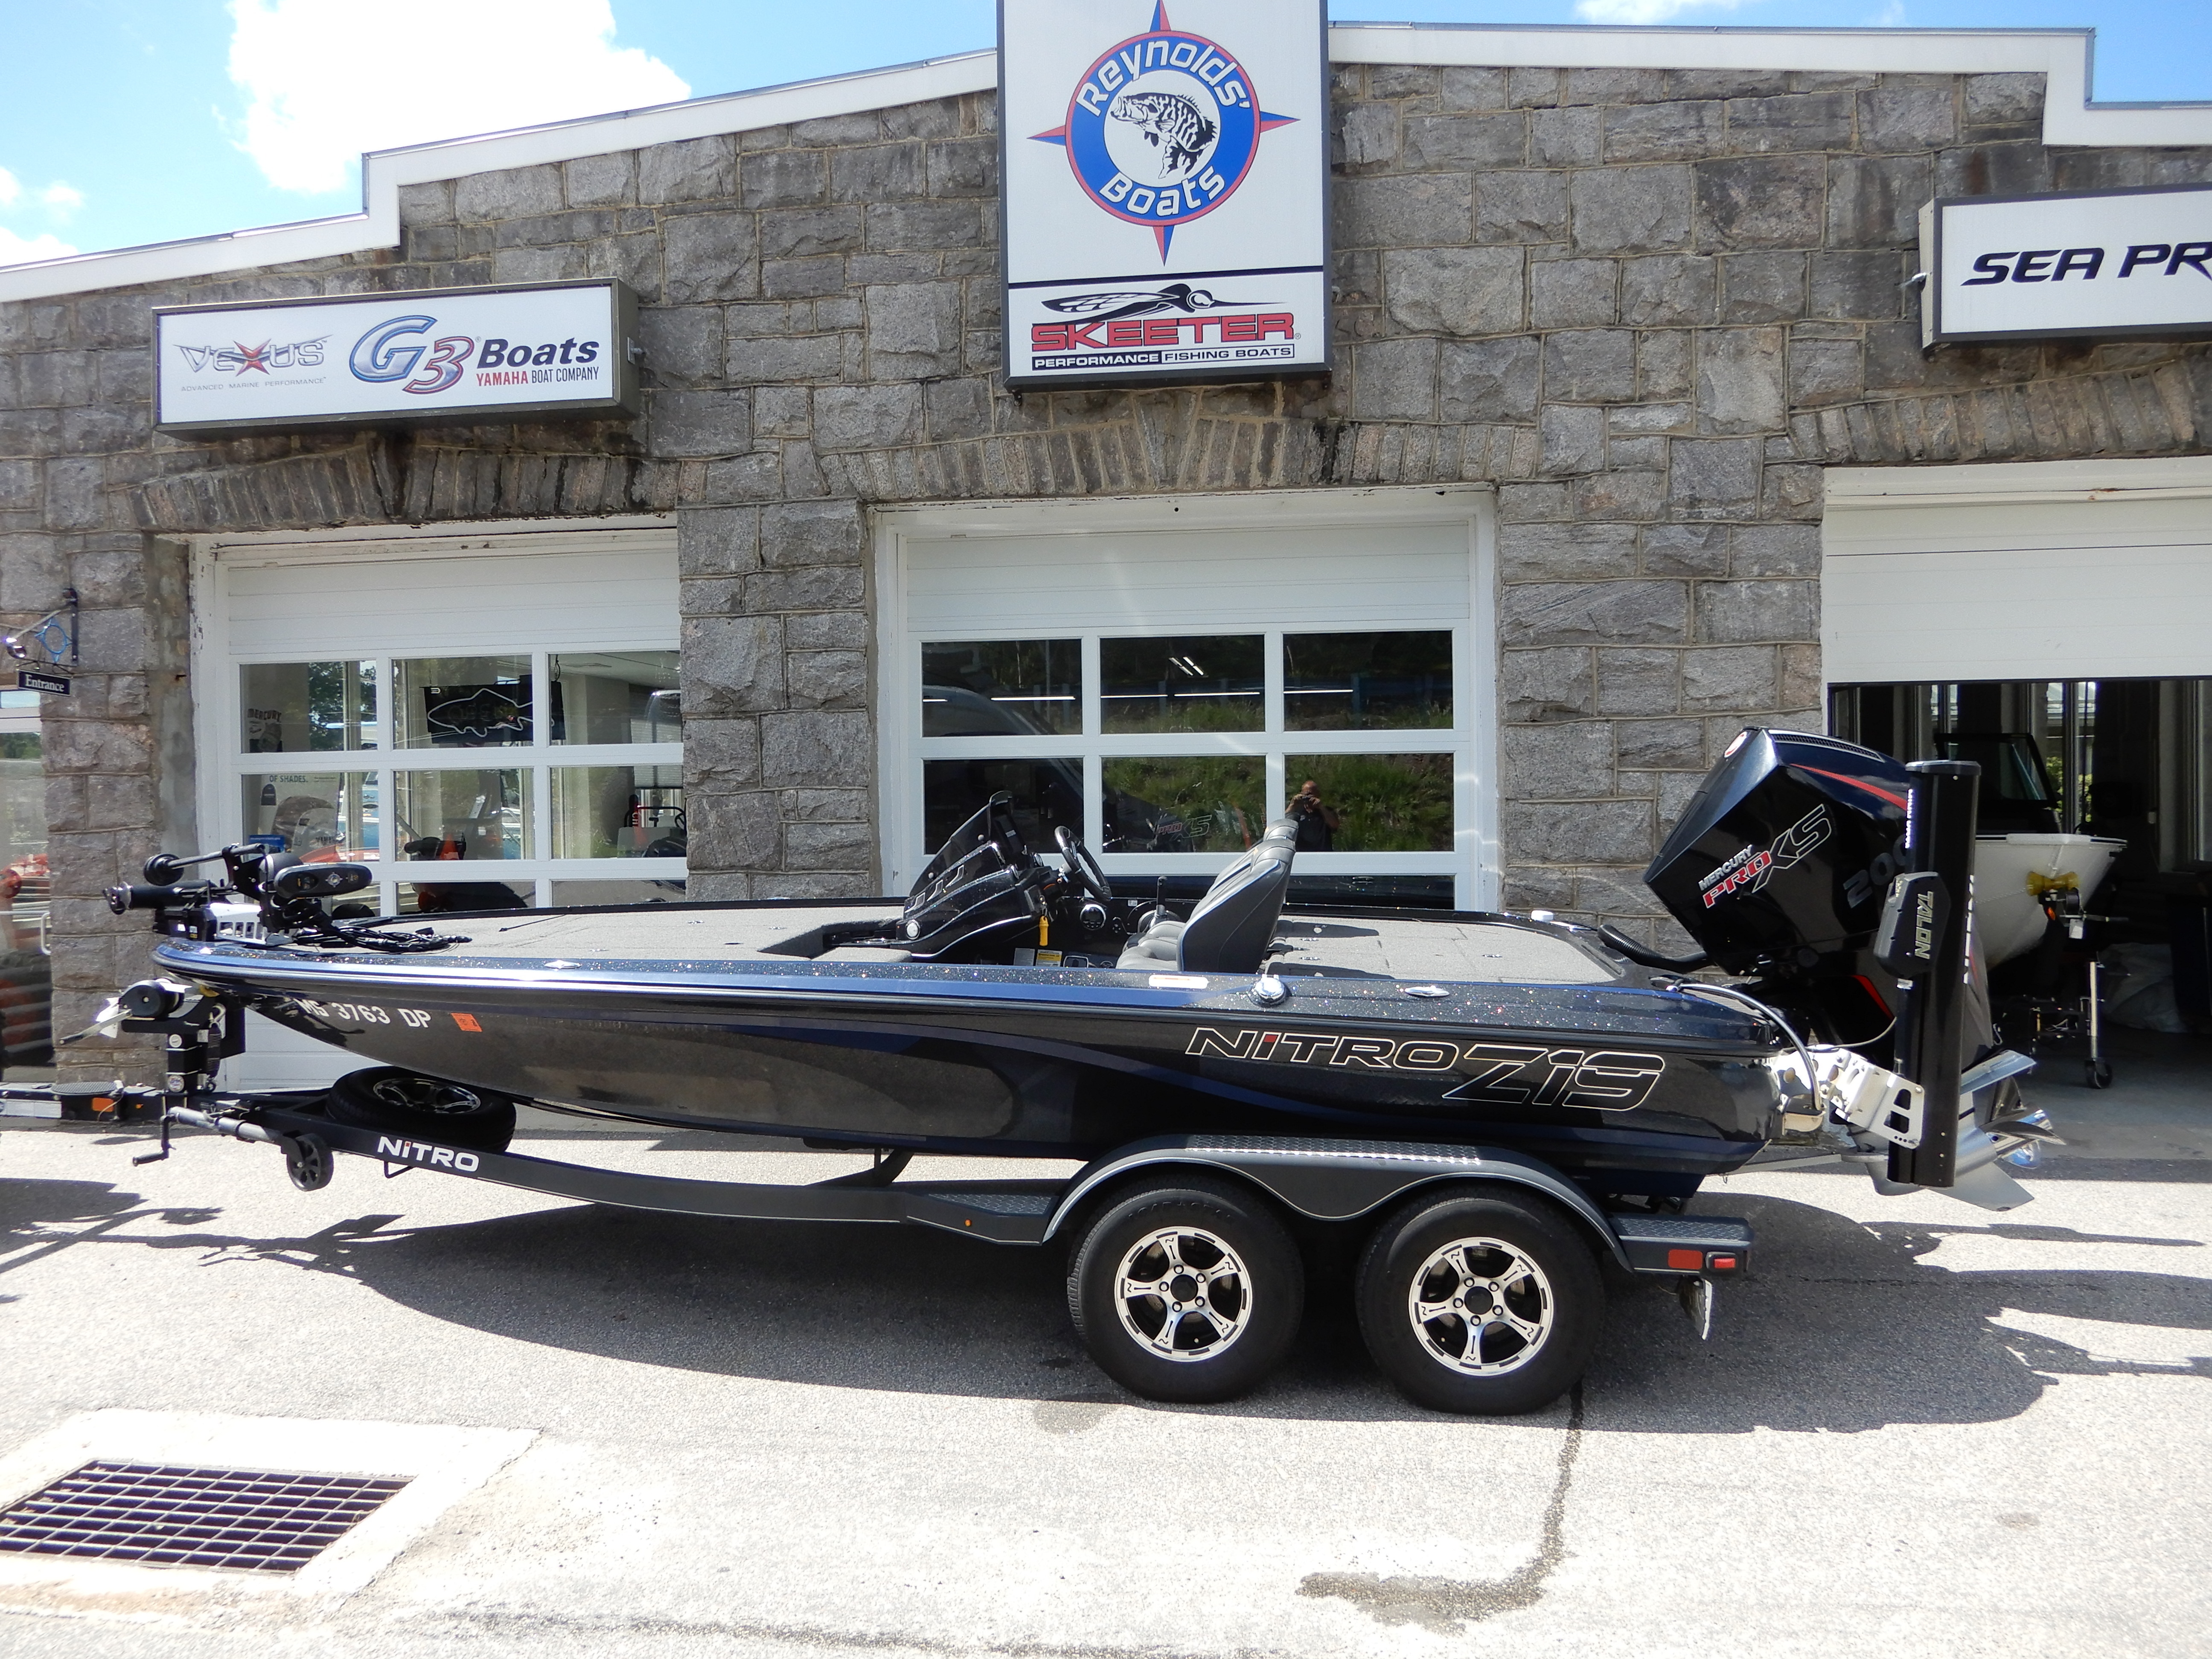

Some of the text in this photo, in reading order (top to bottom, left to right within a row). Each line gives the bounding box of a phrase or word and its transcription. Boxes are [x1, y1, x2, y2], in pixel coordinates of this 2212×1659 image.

[1075, 40, 1250, 117] Reynolds'
[1099, 166, 1225, 217] Boats
[1959, 247, 2105, 287] SEA
[1031, 312, 1294, 352] SKEETER
[173, 334, 333, 377] VEXUS
[349, 314, 600, 394] G3 Boats
[1035, 347, 1291, 368] PERFORMANCE FISHING BOATS
[181, 377, 324, 392] ADVANCED MARINE PERFORMANCE
[476, 366, 600, 387] YAMAHA BOAT COMPANY
[26, 674, 64, 692] Entrance
[1158, 822, 1182, 835] PRO
[1752, 803, 1832, 893] XS
[1698, 844, 1754, 891] MERCURY
[1703, 850, 1772, 909] PRO
[1915, 891, 1934, 960] TALON
[331, 1002, 391, 1024] 3763
[397, 1008, 431, 1028] DP
[1185, 1027, 1665, 1112] NITRO Z19
[378, 1136, 479, 1172] NITRO
